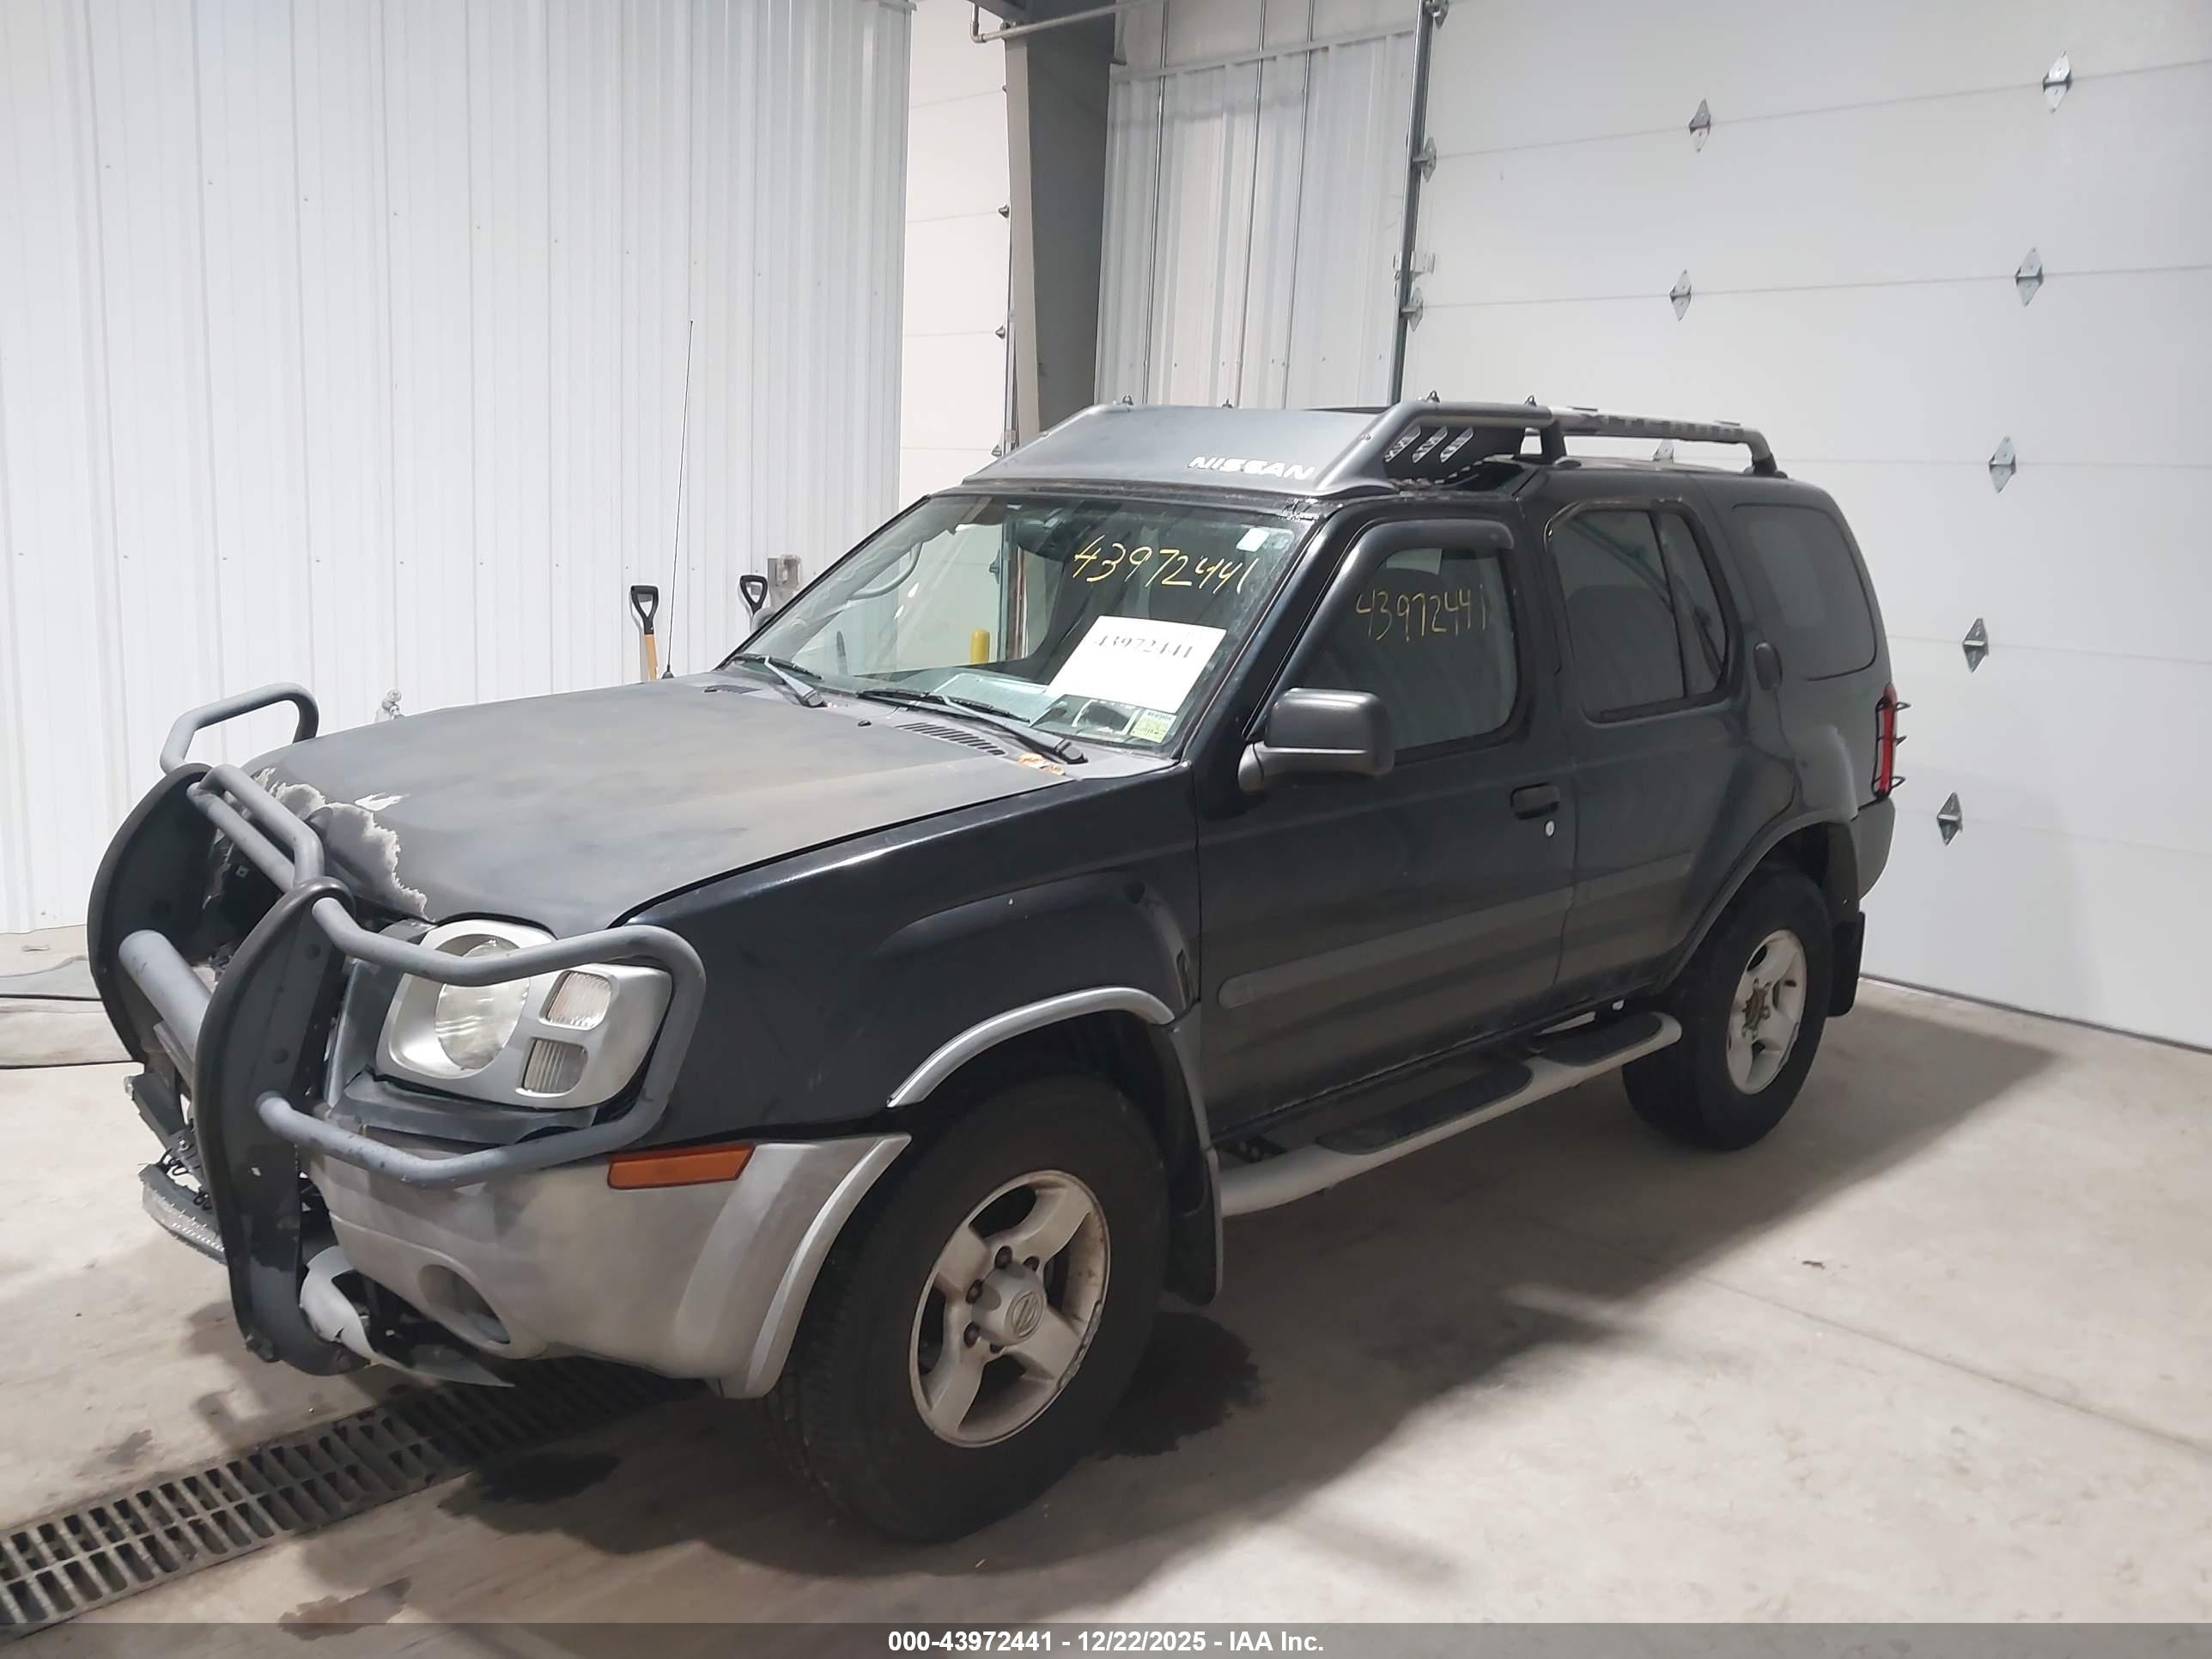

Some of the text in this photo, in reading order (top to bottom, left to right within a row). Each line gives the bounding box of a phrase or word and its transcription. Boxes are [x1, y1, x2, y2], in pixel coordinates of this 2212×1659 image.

[1188, 456, 1316, 481] NISSAN
[1073, 534, 1260, 595] 43972441
[1355, 584, 1486, 642] 43972441
